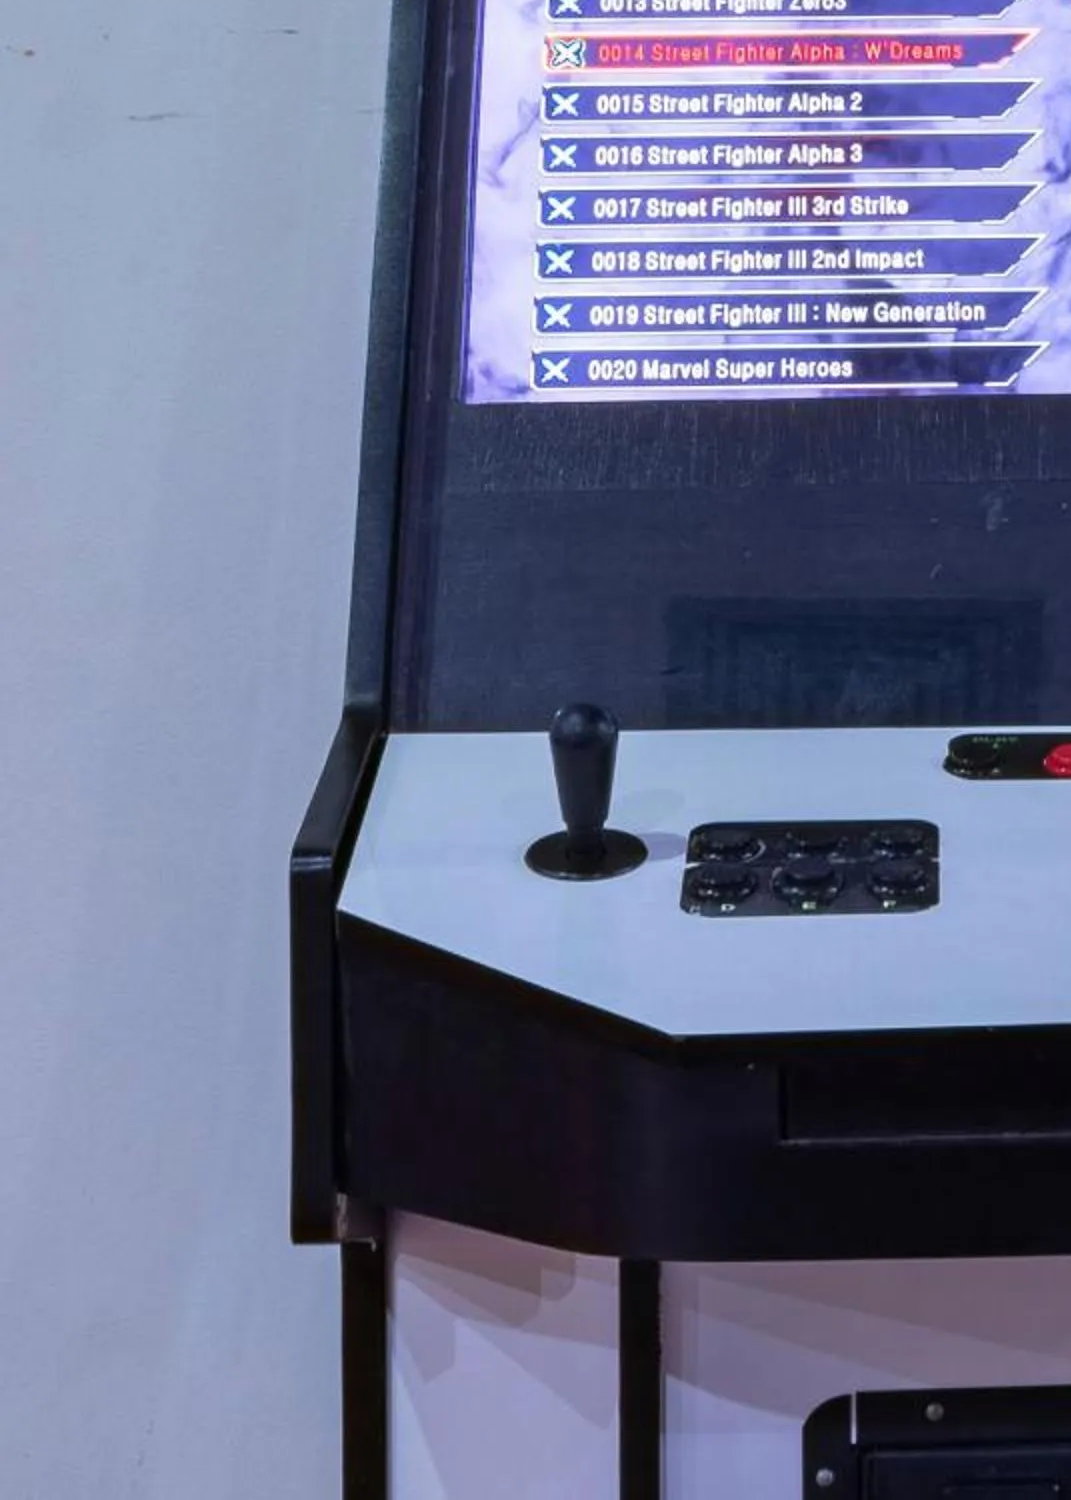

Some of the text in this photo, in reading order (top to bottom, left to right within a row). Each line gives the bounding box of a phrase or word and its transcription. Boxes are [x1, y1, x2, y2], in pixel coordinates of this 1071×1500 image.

[599, 43, 645, 62] 0014
[652, 43, 711, 61] Street
[716, 43, 782, 64] Fighter
[789, 43, 845, 64] Alpha
[864, 42, 963, 60] W'Dreams
[597, 93, 863, 115] 0015 Street Fighter Alpha 2
[595, 145, 863, 166] 0016 Street Fighter Alpha 3
[593, 199, 640, 219] 0017
[646, 199, 707, 218] Street
[712, 198, 782, 220] Fighter
[812, 197, 845, 216] 3rd
[850, 196, 909, 215] Strike
[592, 251, 640, 271] 0018
[645, 250, 706, 271] Street
[712, 250, 782, 273] Fighter
[812, 249, 850, 269] 2nd
[855, 248, 925, 270] Impact
[589, 306, 638, 326] 0019
[643, 306, 706, 325] Street
[710, 305, 781, 327] Fighter
[825, 304, 867, 322] New
[873, 302, 986, 321] Generation
[588, 358, 853, 384] 0020 Marvel Super Heroes
